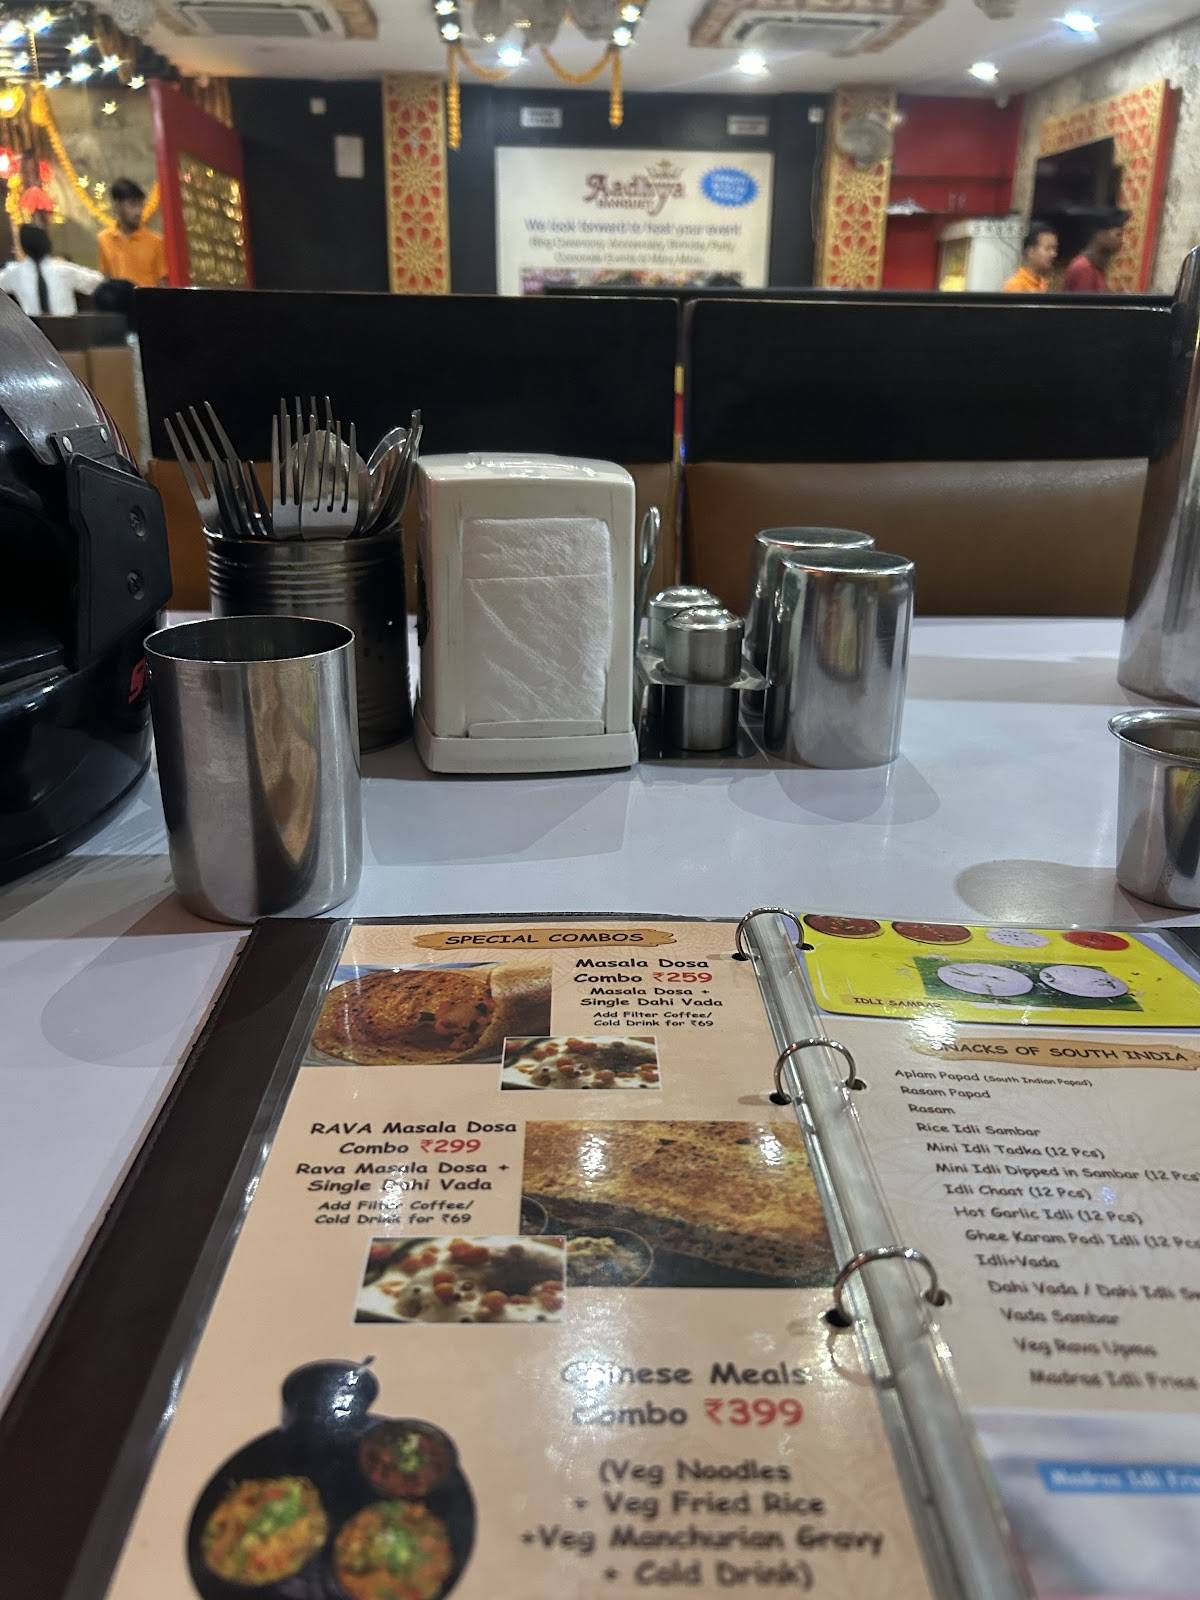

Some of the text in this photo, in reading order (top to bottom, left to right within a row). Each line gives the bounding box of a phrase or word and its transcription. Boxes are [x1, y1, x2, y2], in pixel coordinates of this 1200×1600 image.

[583, 173, 686, 217] Aadhya
[526, 218, 546, 232] We
[445, 932, 645, 945] SPECIAL COMBOS
[576, 958, 709, 968] Masala Dosa
[573, 972, 713, 983] Combo ₹259
[590, 987, 647, 995] Masala
[654, 987, 693, 995] Dosa
[580, 998, 723, 1008] Single Dahi Vada
[853, 997, 883, 1005] IDLI
[931, 1043, 1188, 1062] NACKS OF SOUTH INDIA
[895, 1069, 1093, 1087] Aplam Papad (South Indian Papad)
[900, 1086, 991, 1099] Rasam Papad
[908, 1103, 956, 1115] Rasam
[310, 1121, 517, 1134] RAVA Masala Dosa
[916, 1122, 1041, 1137] Rice Idli Sambar
[339, 1139, 481, 1154] Combo ₹299
[926, 1142, 1106, 1160] Mini Idli Tadka (12 Pcs)
[296, 1163, 345, 1175] Rava
[355, 1161, 428, 1174] Masala
[438, 1162, 488, 1173] Dosa
[935, 1162, 969, 1174] Mini
[973, 1163, 1001, 1175] Idli
[1005, 1165, 1060, 1179] Dipped
[1063, 1167, 1078, 1178] in
[1082, 1167, 1140, 1180] Sambar
[1144, 1168, 1168, 1181] (12
[307, 1179, 371, 1195] Single
[440, 1178, 492, 1191] Vada
[943, 1183, 1092, 1200] Idli Chaat (12 Pcs)
[318, 1201, 351, 1211] Add
[410, 1201, 475, 1211] Coffee/
[315, 1214, 350, 1225] Cold
[408, 1213, 434, 1224] for
[442, 1214, 472, 1223] ₹69
[954, 1206, 1142, 1225] Hot Garlic Idli (12 Pcs)
[965, 1229, 1008, 1242] Ghee
[1012, 1230, 1066, 1244] Karam
[1108, 1233, 1140, 1247] Idli
[1144, 1235, 1171, 1249] (12
[987, 1280, 1029, 1293] Dahi
[1033, 1281, 1079, 1295] Vada
[1000, 1307, 1048, 1322] Vada
[1013, 1336, 1052, 1355] Veg
[709, 1360, 810, 1386] Meals
[704, 1399, 804, 1426] ₹399
[599, 1458, 791, 1485] (Veg Noodles
[604, 1492, 661, 1520] Veg
[671, 1491, 751, 1515] Fried
[764, 1492, 825, 1515] Rice
[520, 1525, 884, 1558] +Veg Manchurian Gravy
[634, 1559, 703, 1588] Cold
[715, 1560, 814, 1591] Drink)
